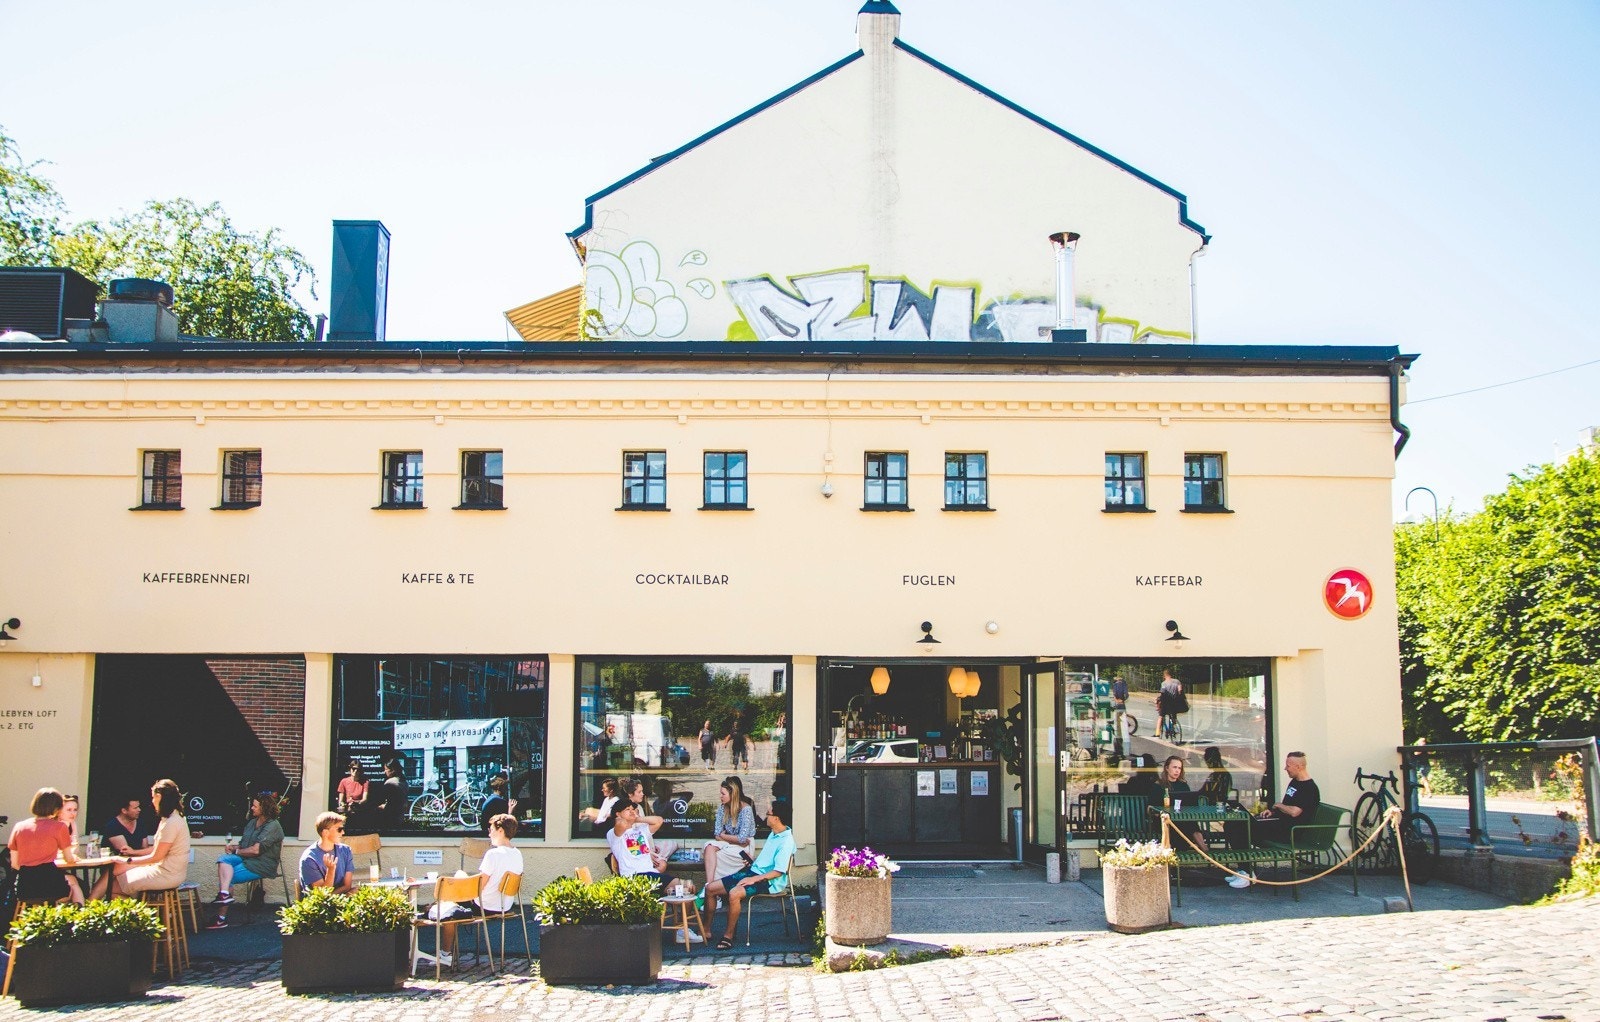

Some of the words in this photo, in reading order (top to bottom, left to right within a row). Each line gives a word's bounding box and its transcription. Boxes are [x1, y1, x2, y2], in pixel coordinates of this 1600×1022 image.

[142, 572, 251, 585] KAFFEBRENNERI
[401, 573, 444, 584] KAFFE
[446, 573, 456, 584] &
[459, 573, 475, 584] TE
[635, 573, 730, 586] COCKTAILBAR
[902, 575, 956, 586] FUGLEN
[1135, 575, 1203, 586] KAFFEBAR
[18, 722, 34, 730] ETG
